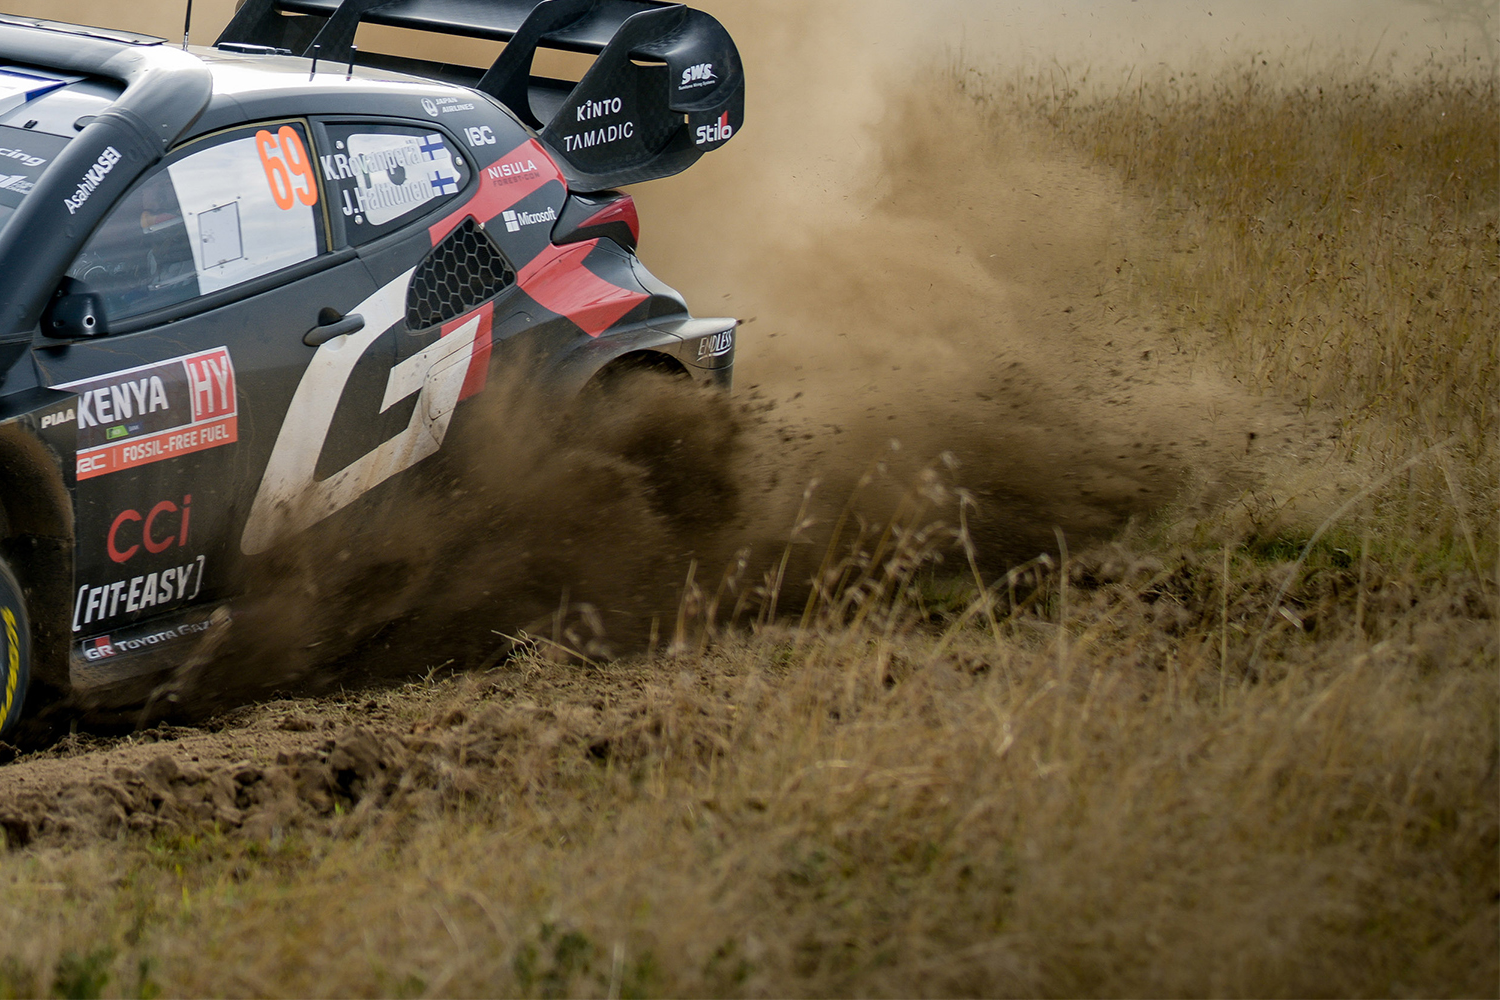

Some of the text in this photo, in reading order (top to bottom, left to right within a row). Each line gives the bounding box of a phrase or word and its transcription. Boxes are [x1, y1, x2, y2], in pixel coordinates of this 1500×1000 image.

[681, 63, 713, 85] SWS
[435, 97, 458, 106] JAPAN
[442, 103, 475, 114] AIRLINES
[564, 122, 634, 152] TAMADIC
[696, 114, 733, 145] Stilo
[255, 125, 318, 210] 69
[487, 159, 538, 180] NISULA
[517, 206, 558, 227] Microsoft
[698, 328, 732, 356] ENDLESS
[189, 356, 228, 416] HY
[77, 375, 169, 430] KENYA
[41, 409, 76, 429] PIAA
[123, 432, 198, 464] FOSSIL-FREE
[200, 424, 230, 445] FUEL
[84, 643, 115, 661] GR
[114, 630, 178, 653] TOYOTA
